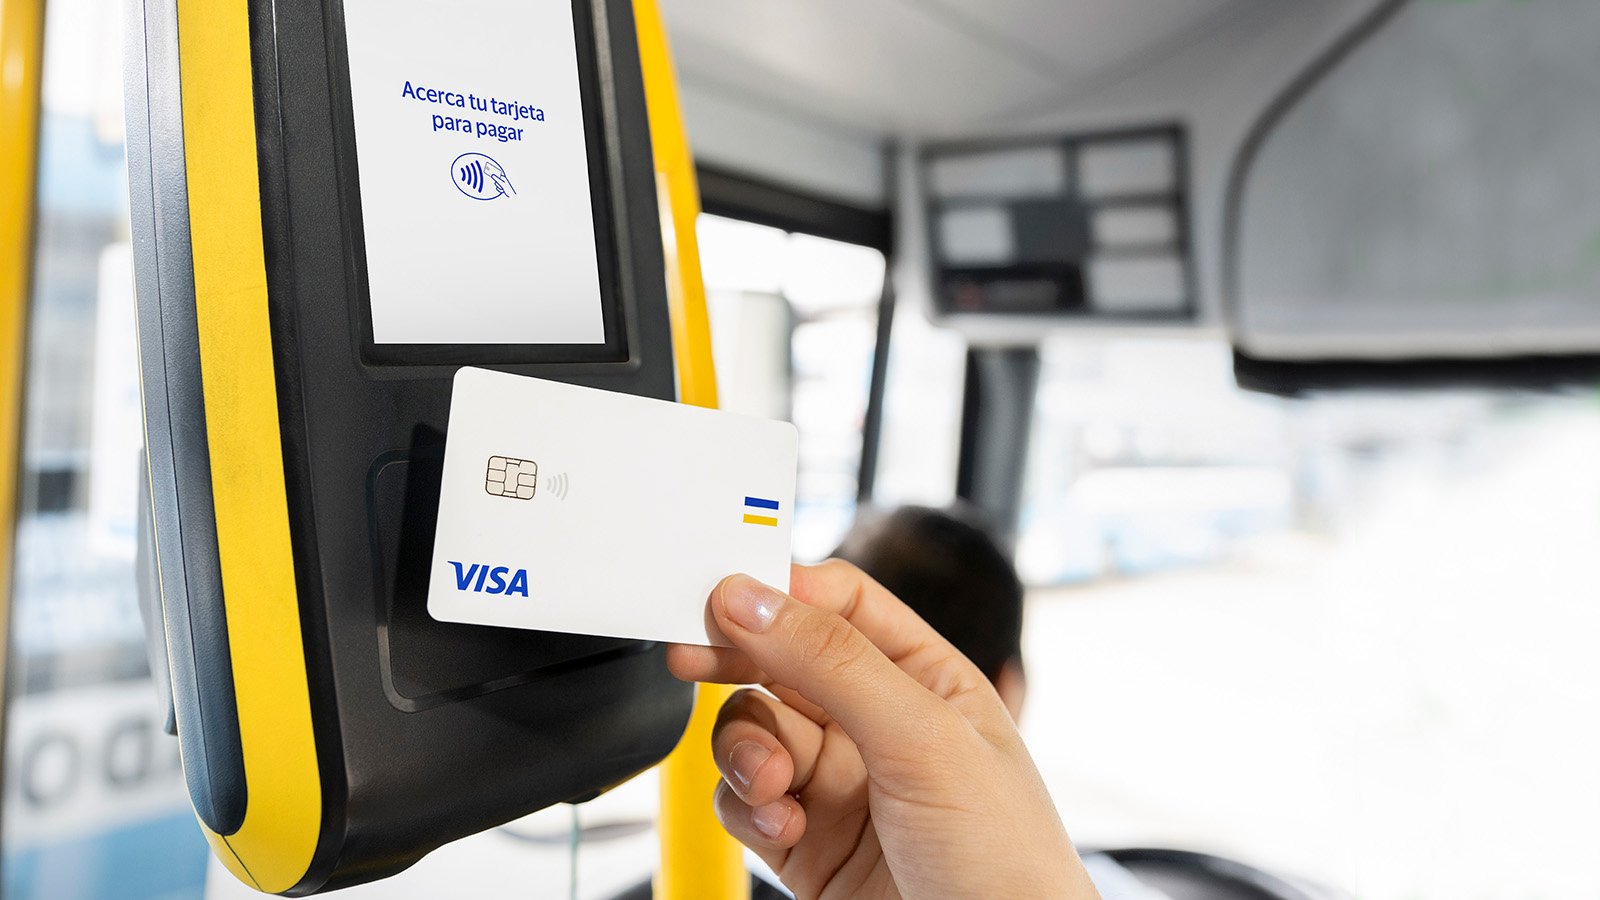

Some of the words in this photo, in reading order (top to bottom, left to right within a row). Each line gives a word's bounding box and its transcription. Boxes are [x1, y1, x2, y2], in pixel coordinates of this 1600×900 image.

[402, 81, 465, 108] Acerca
[468, 94, 488, 112] tu
[490, 97, 545, 122] tarjeta
[432, 114, 472, 133] para
[476, 121, 524, 143] pagar
[448, 560, 529, 598] VISA
